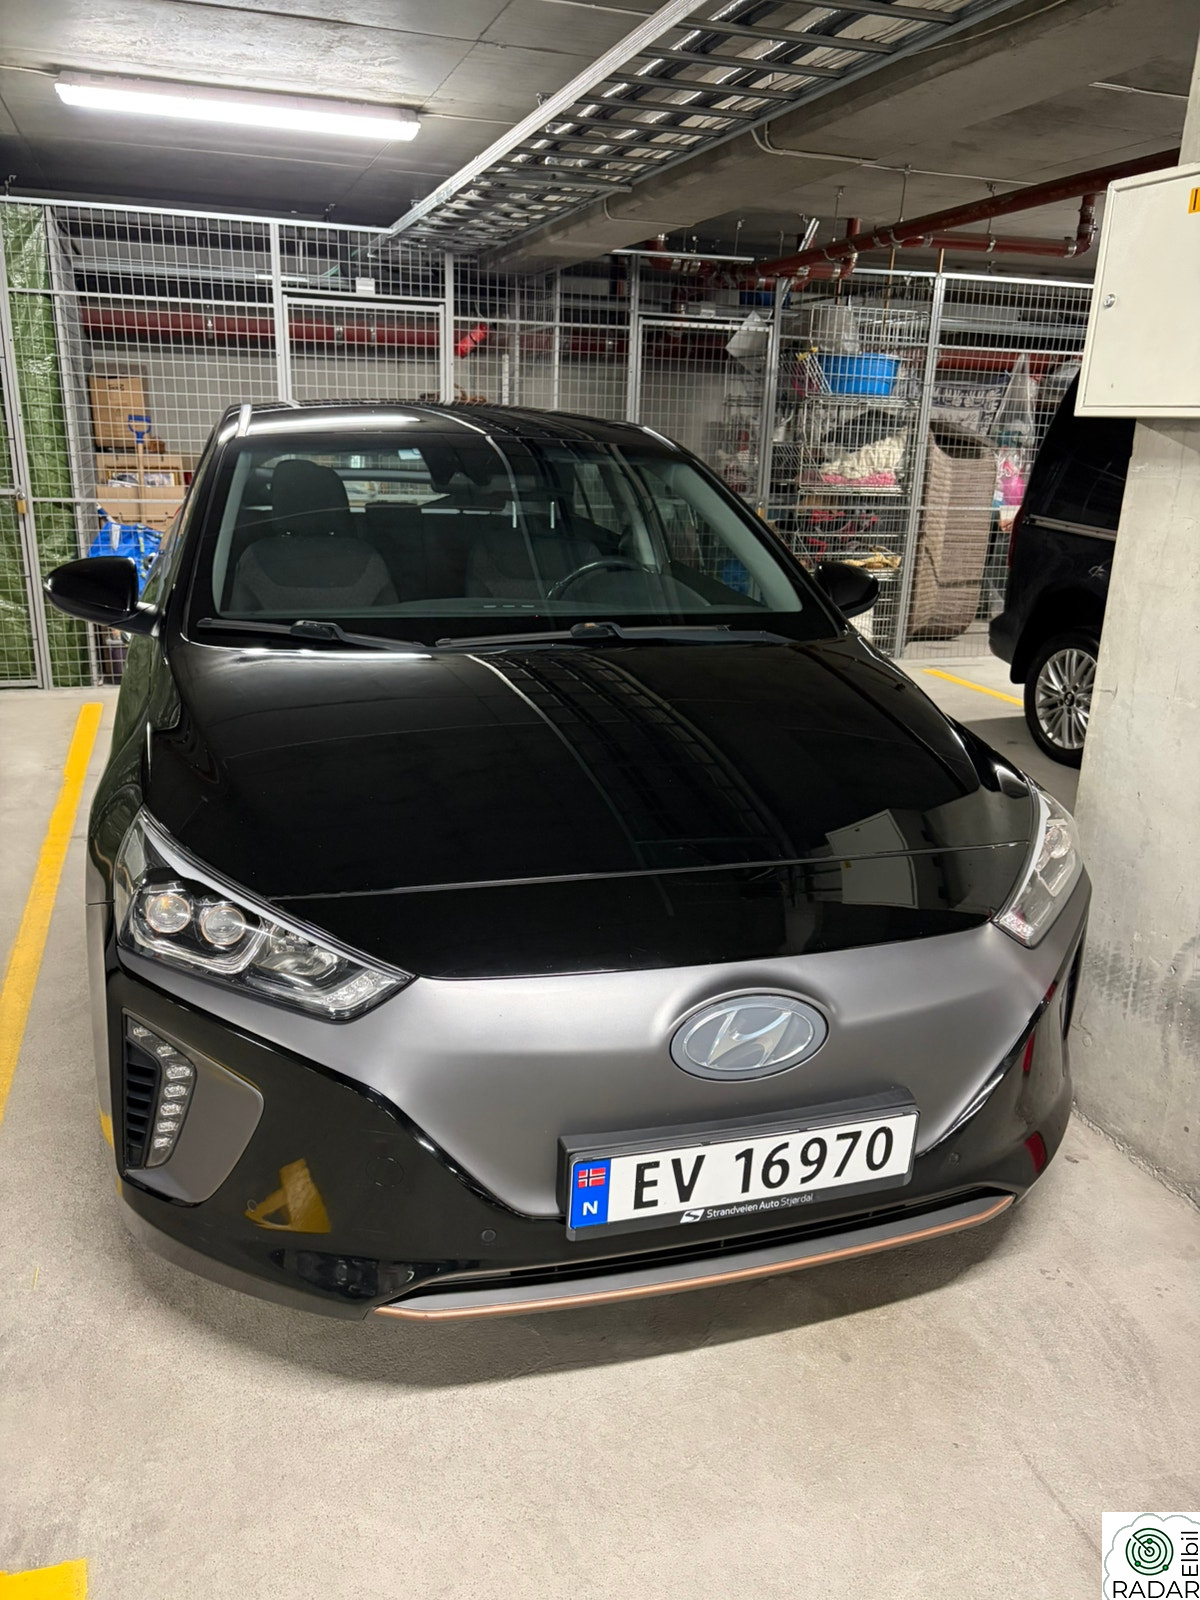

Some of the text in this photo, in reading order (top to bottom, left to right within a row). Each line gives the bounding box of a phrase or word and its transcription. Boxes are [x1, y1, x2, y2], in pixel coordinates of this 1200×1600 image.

[633, 1126, 893, 1210] EV 16970
[582, 1200, 598, 1216] N
[706, 1193, 814, 1218] Strandveien Auto Stjørdal
